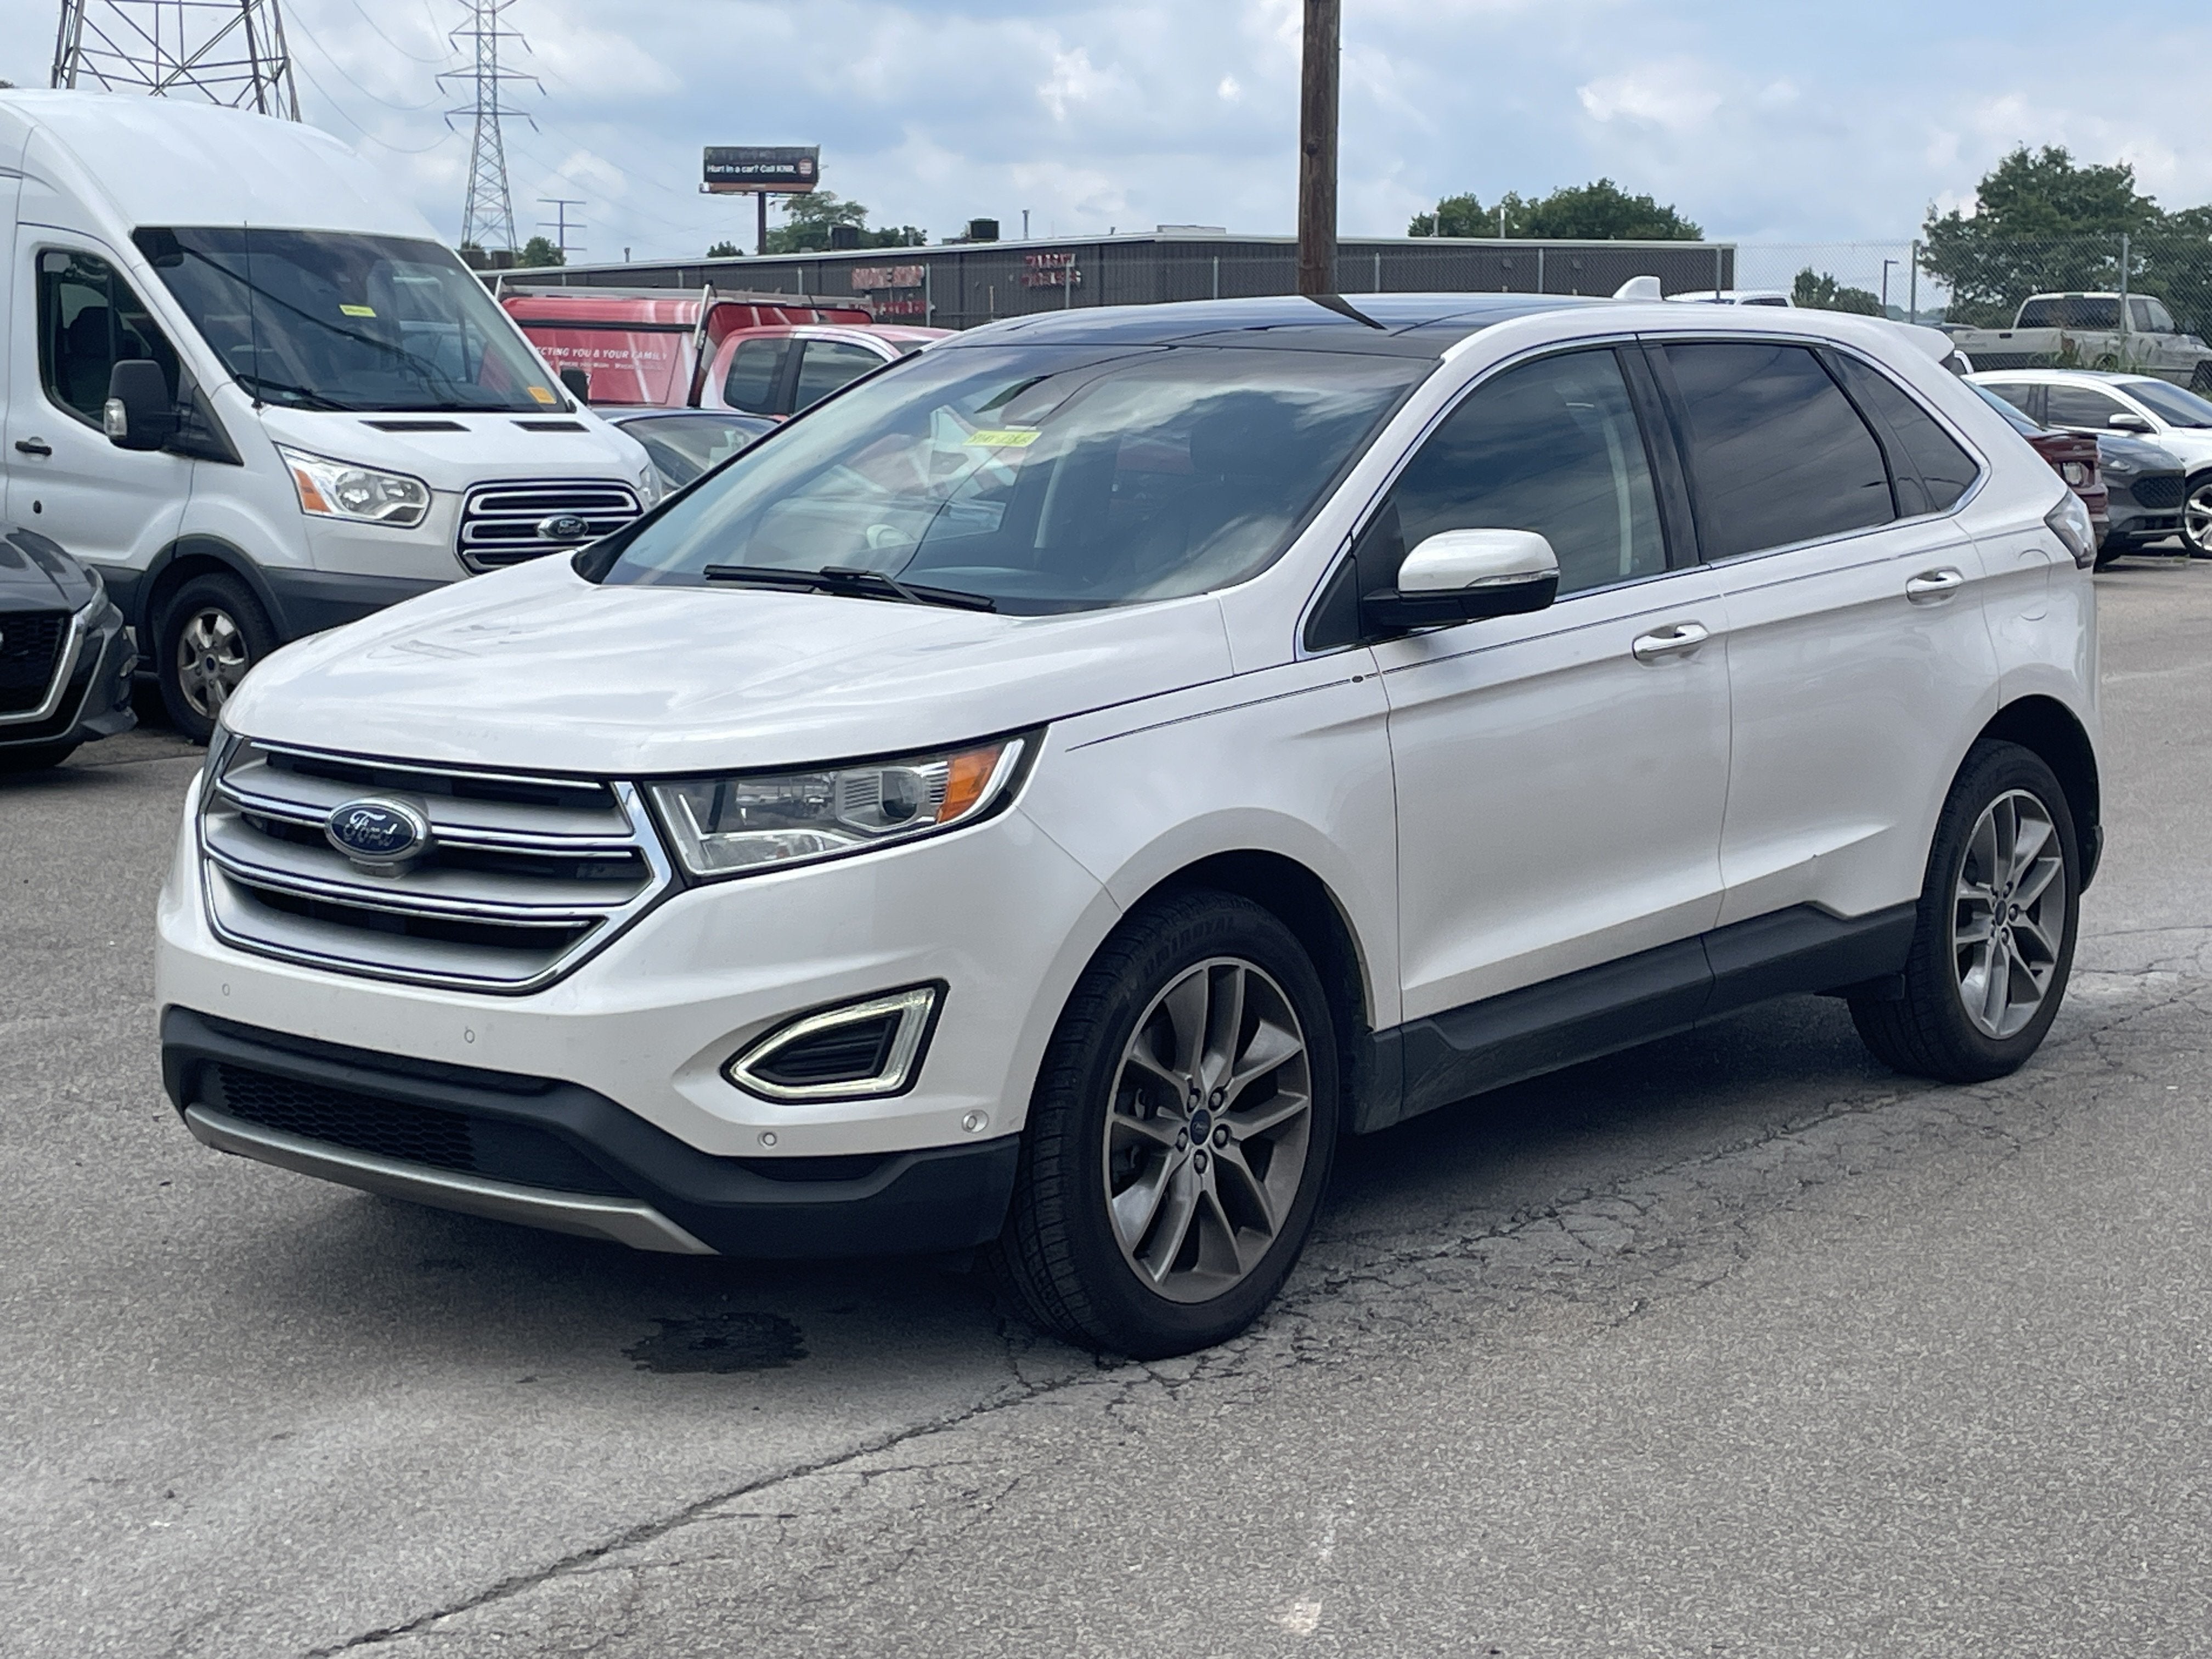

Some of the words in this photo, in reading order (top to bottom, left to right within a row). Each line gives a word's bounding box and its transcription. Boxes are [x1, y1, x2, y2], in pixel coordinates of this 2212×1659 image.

[573, 348, 592, 357] YOU
[593, 349, 600, 358] &
[603, 349, 629, 359] YOUR
[343, 810, 398, 847] Ford
